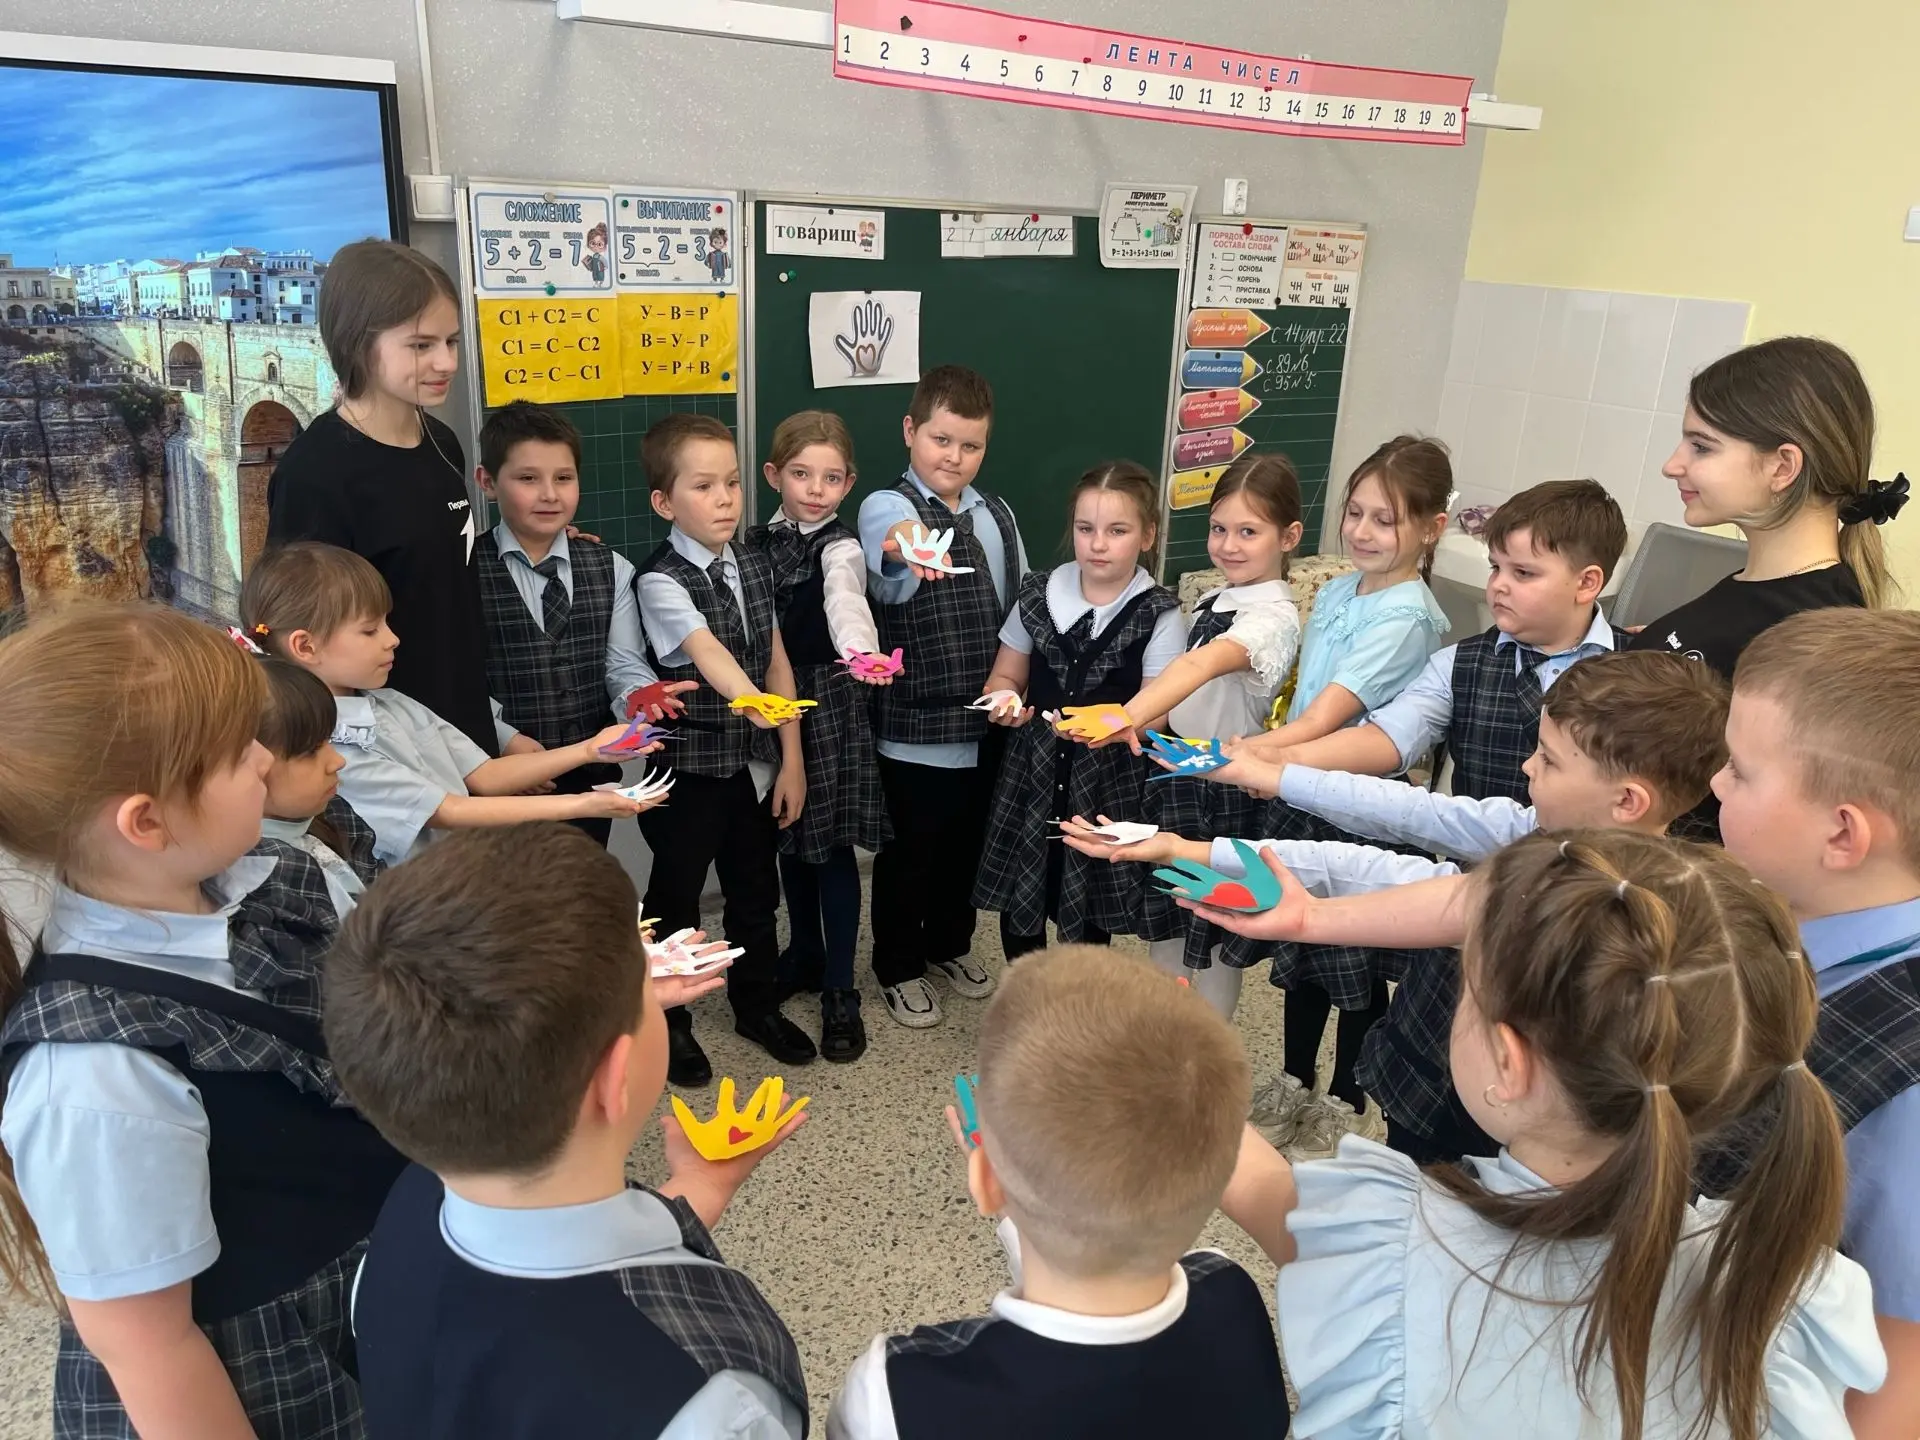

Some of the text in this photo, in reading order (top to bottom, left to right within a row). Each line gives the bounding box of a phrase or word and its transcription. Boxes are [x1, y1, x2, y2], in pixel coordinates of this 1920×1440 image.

[1106, 44, 1300, 85] ЛЕНТА ЧИСЕЛ
[844, 34, 1456, 127] 1 2 3 4 5 6 7 8 9 10 11 12 13 14 15 16 17 18 19 20
[1130, 192, 1166, 200] ПЕРИМЕТР
[504, 200, 582, 223] СЛОЖЕНИЕ
[636, 200, 712, 221] ВЫЧИТАНИЕ
[991, 216, 1068, 252] января
[1209, 232, 1279, 243] ПОРЯДОК РАЗБОРА
[485, 239, 500, 266] 5
[528, 240, 542, 266] 2
[568, 240, 582, 266] 7
[622, 234, 636, 260] 5
[658, 235, 670, 260] 2
[694, 236, 706, 262] 3
[1213, 240, 1272, 251] СОСТАВА СЛОВА
[1289, 240, 1350, 253] ЖИ ЧА ЧУ
[1240, 254, 1277, 262] ОКОНЧАНИЕ
[1288, 252, 1350, 266] ШИ ЩА ЩУ
[1290, 282, 1350, 294] ЧН ЧТ ЩН
[1289, 294, 1300, 303] ЧК
[1310, 294, 1324, 305] РЩ
[499, 310, 522, 326] С1
[544, 308, 566, 324] С2
[586, 308, 600, 322] С
[640, 304, 652, 320] У
[671, 306, 681, 320] В
[700, 306, 709, 320] Р
[1192, 320, 1226, 336] Русский
[1328, 322, 1346, 344] 22
[502, 340, 525, 356] С1
[546, 338, 559, 353] С
[578, 336, 600, 352] С2
[642, 334, 652, 348] В
[670, 334, 682, 348] У
[700, 334, 709, 348] Р
[504, 368, 528, 384] С2
[548, 367, 561, 382] С
[580, 365, 601, 380] С1
[642, 360, 652, 375] У
[672, 360, 682, 374] Р
[700, 360, 710, 374] В
[1188, 361, 1242, 373] Математика
